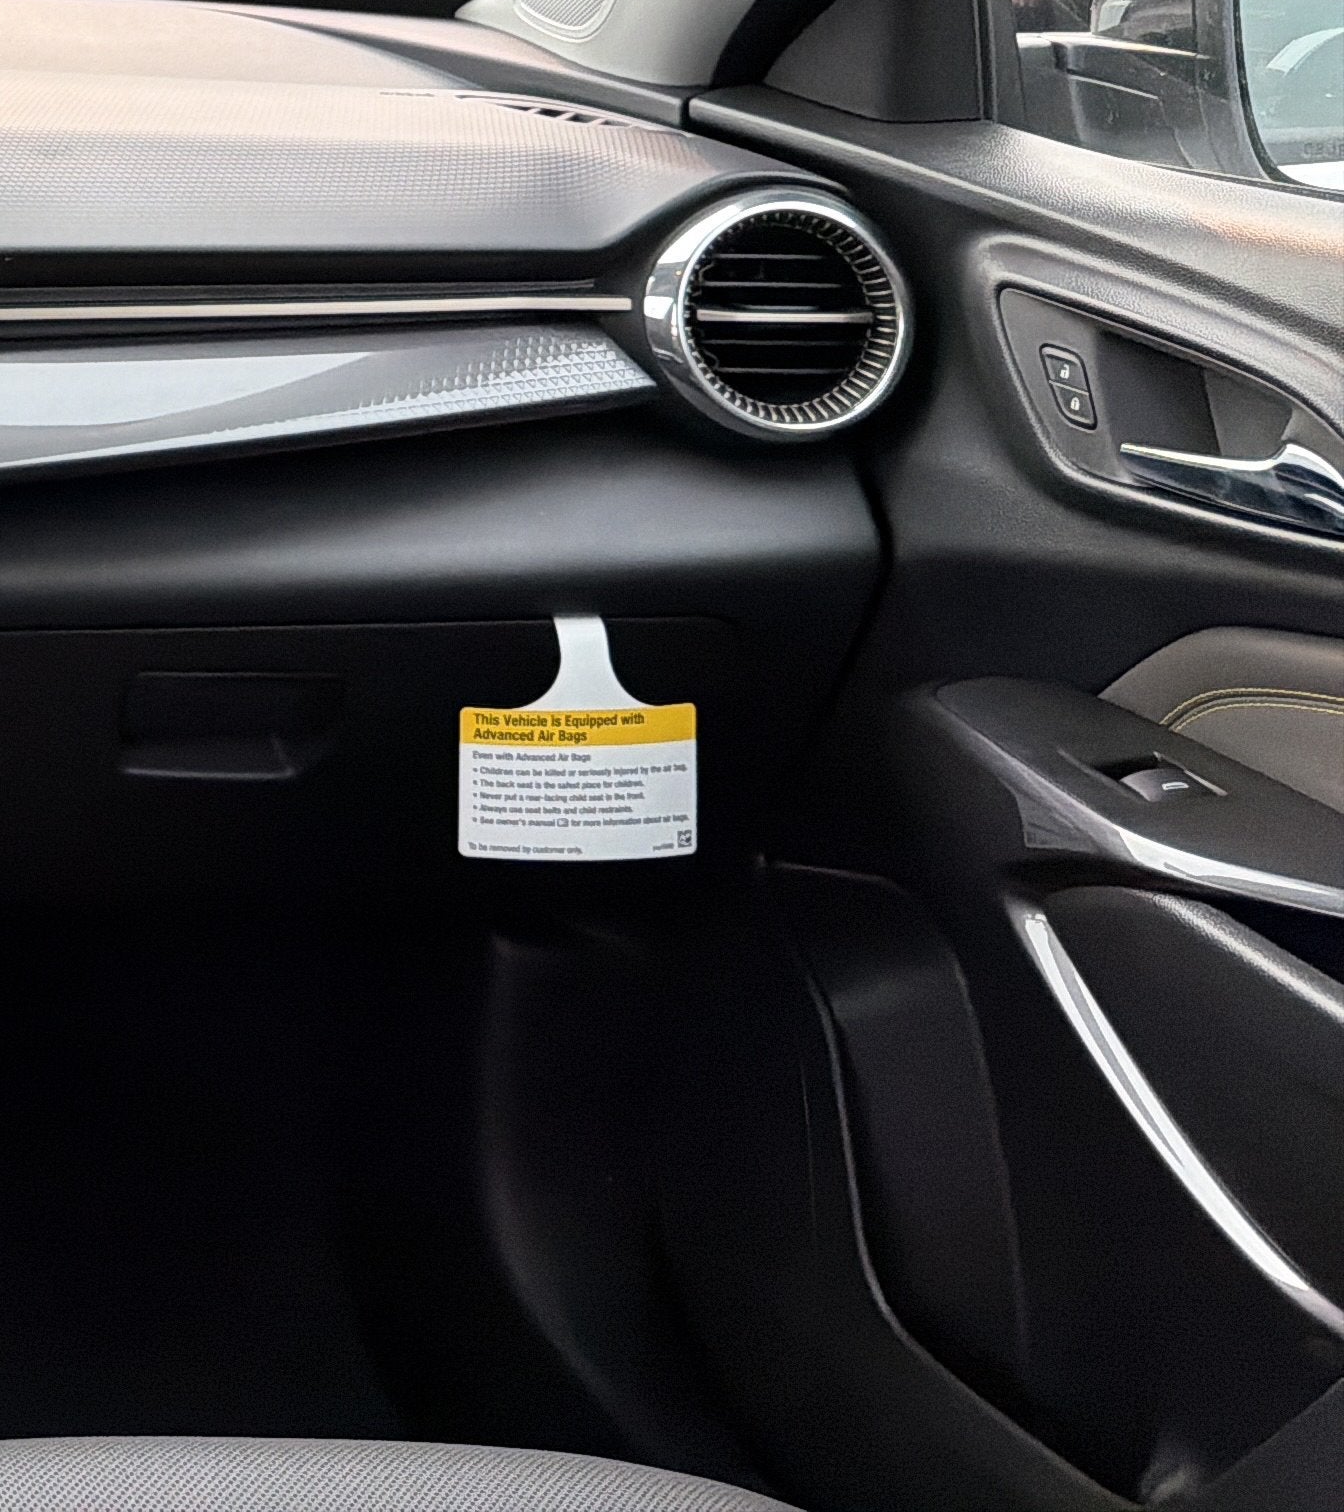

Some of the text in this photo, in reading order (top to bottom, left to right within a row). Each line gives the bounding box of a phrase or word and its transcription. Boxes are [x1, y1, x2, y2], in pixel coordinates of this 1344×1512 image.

[473, 712, 500, 727] This
[503, 714, 548, 727] Vehicle
[564, 713, 618, 729] Equipped
[621, 712, 645, 725] with
[473, 727, 588, 744] Advanced Air Bags
[472, 750, 493, 760] Even
[495, 752, 514, 760] with
[515, 753, 556, 762] Advanced
[558, 752, 570, 761] Air
[480, 766, 514, 776] Children
[480, 779, 495, 788] The
